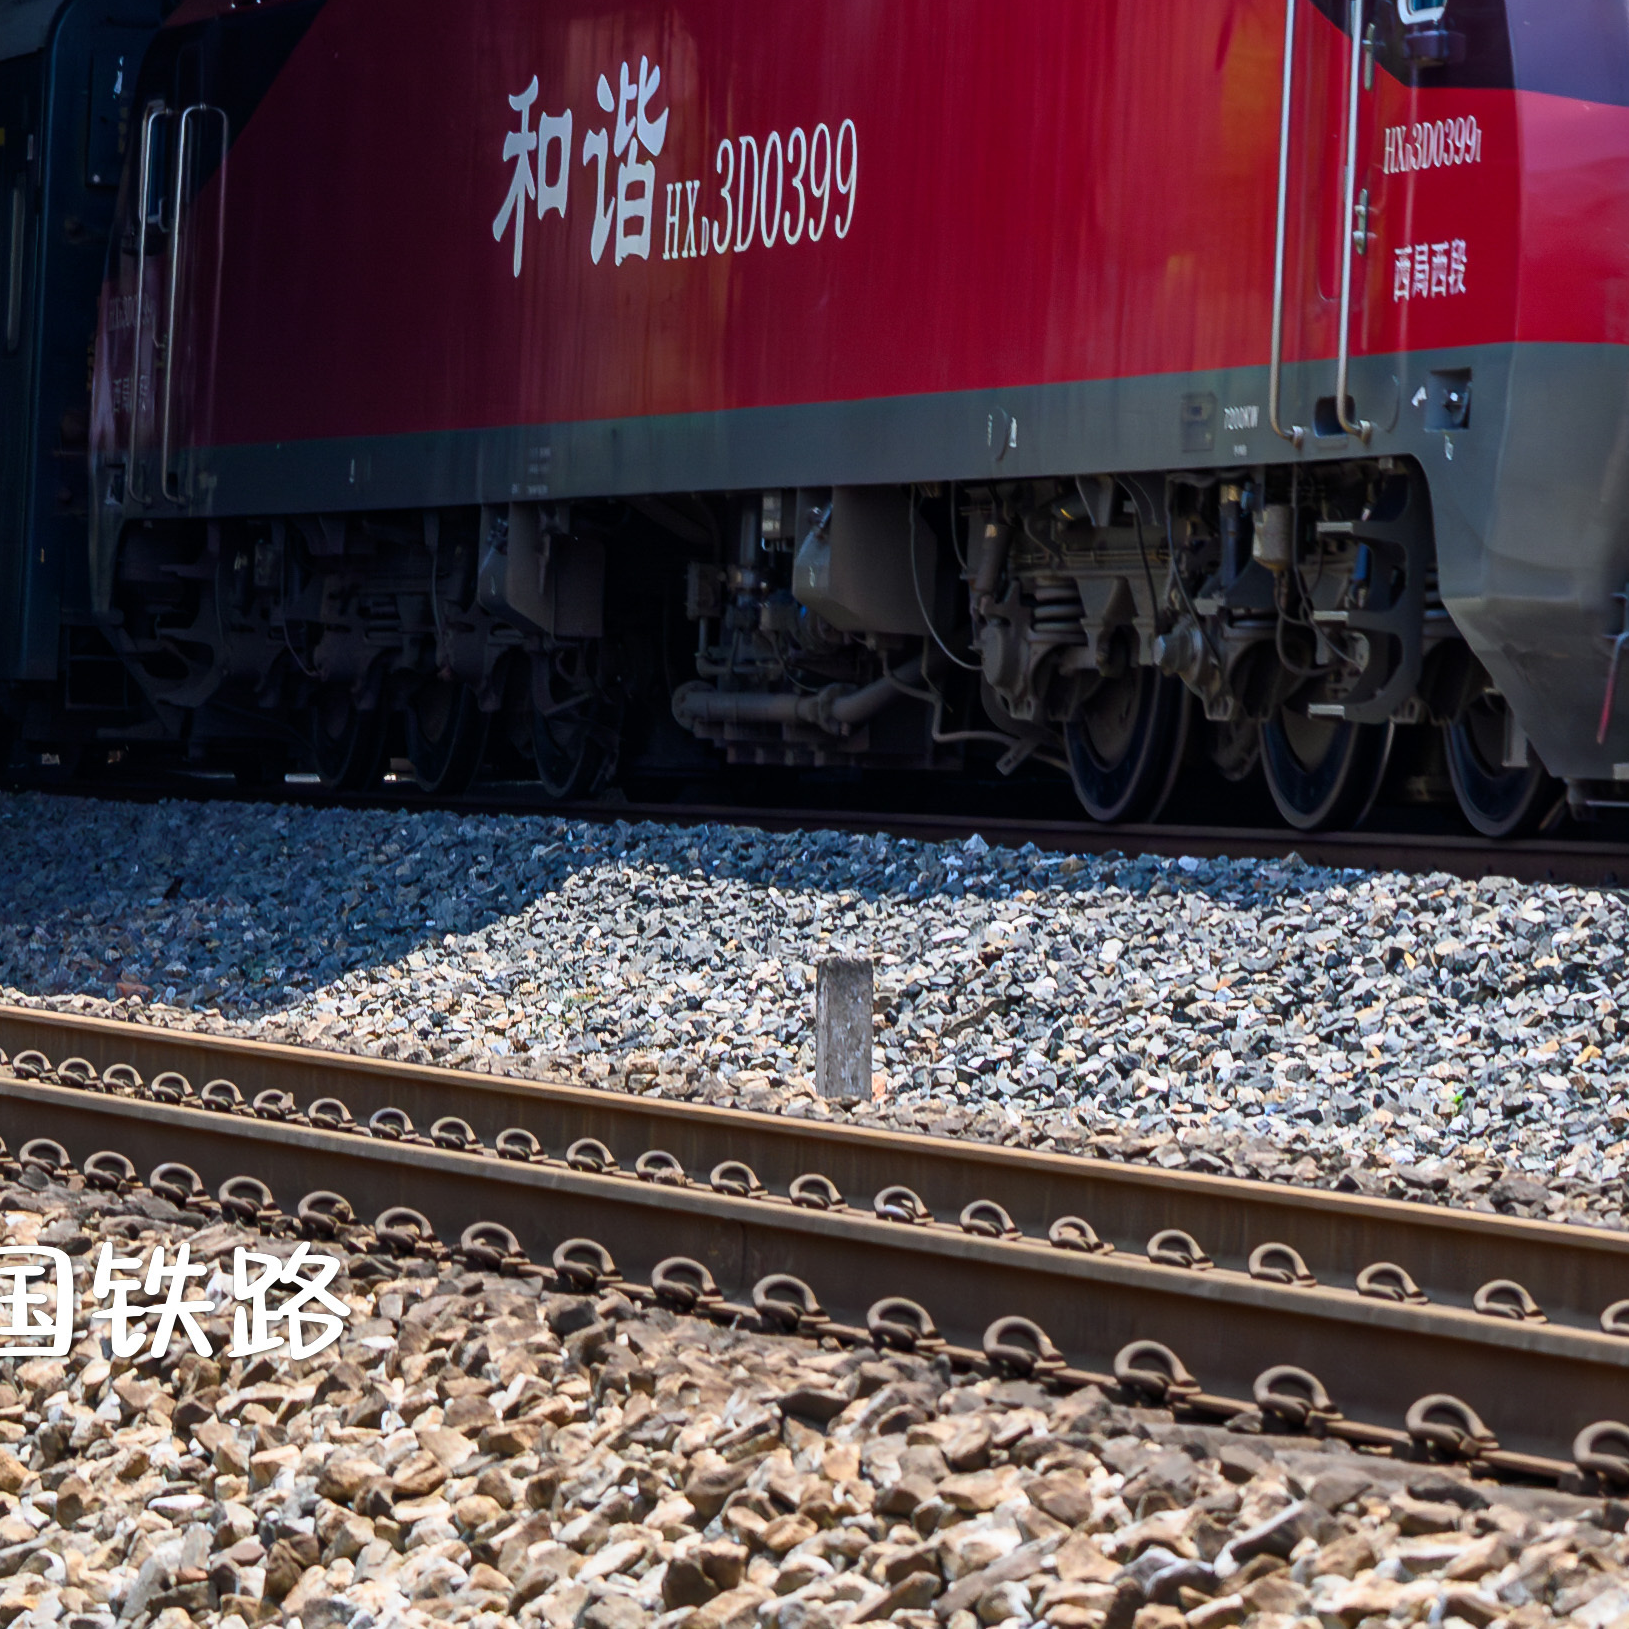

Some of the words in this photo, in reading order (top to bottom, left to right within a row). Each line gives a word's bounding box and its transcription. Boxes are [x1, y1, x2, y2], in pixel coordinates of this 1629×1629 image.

[492, 54, 669, 278] 和谐
[1393, 237, 1467, 304] 西局西段
